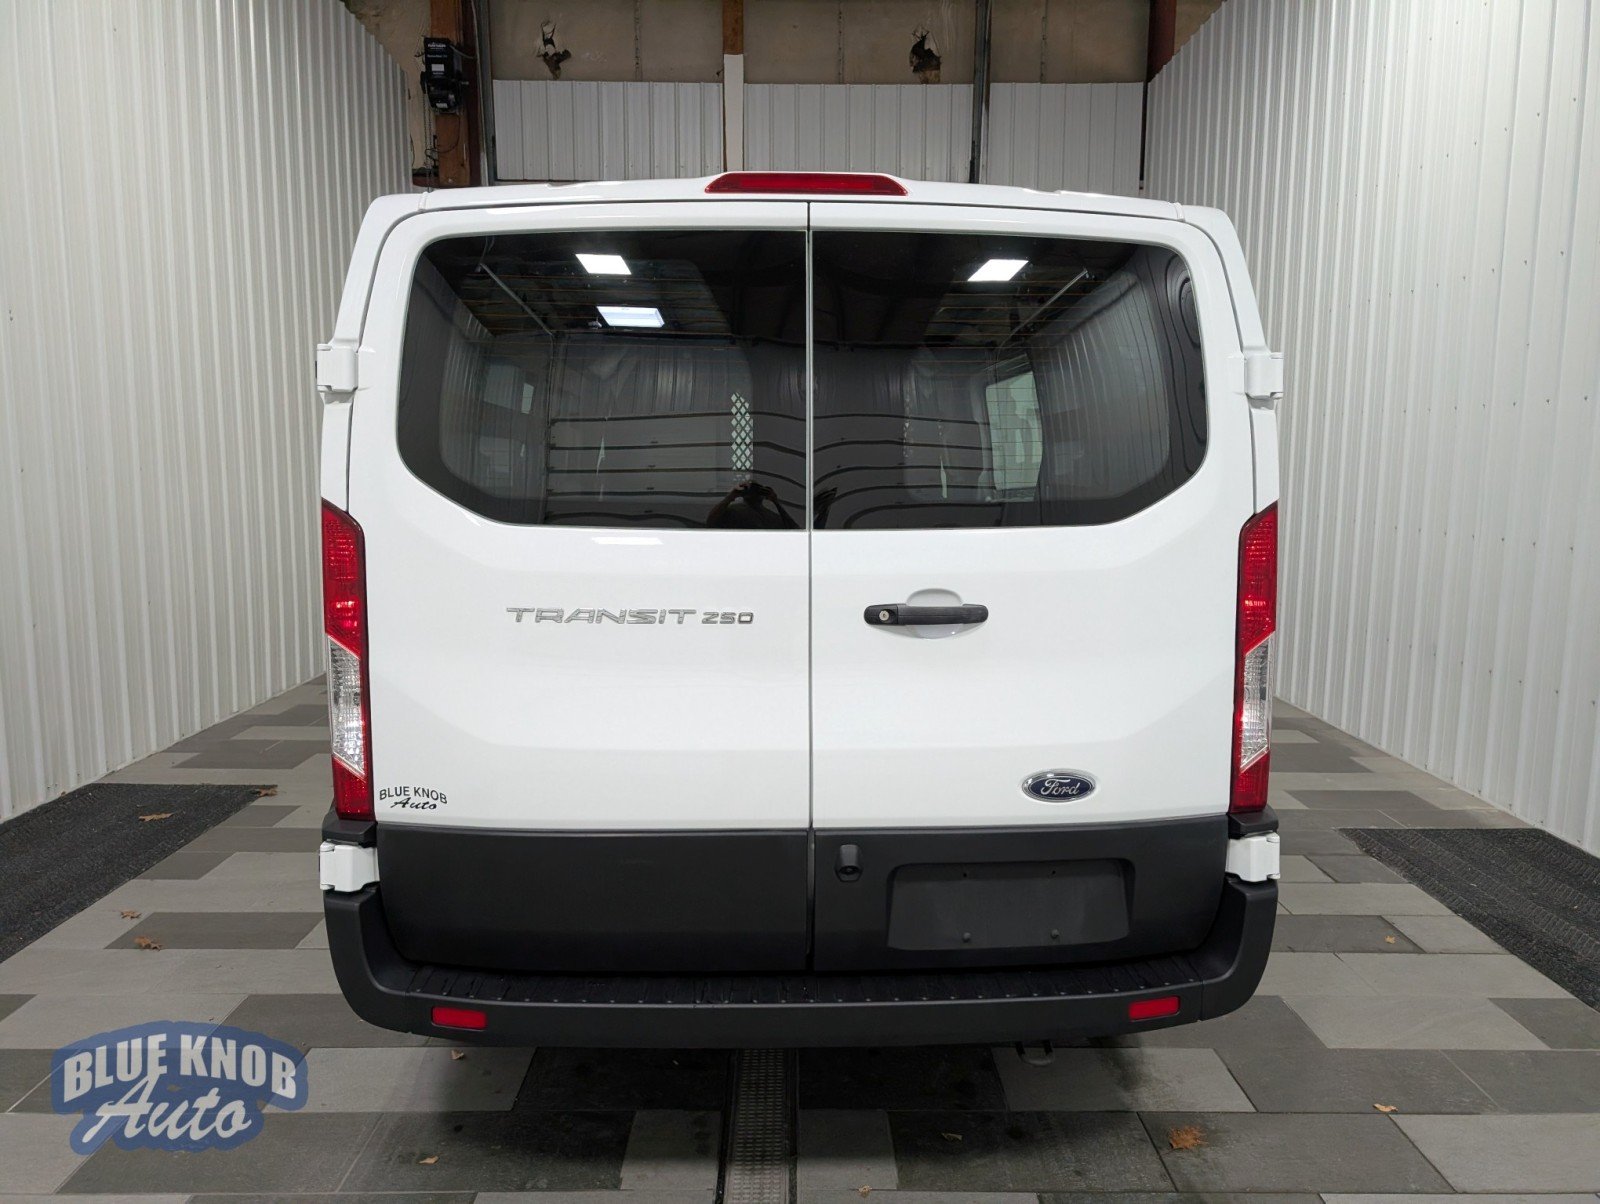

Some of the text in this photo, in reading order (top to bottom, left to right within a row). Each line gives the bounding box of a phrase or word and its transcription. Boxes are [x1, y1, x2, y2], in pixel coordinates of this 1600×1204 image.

[506, 607, 754, 624] TRANSIT 250
[379, 786, 448, 804] BLUE KNOB
[1040, 778, 1081, 795] Ford
[390, 797, 437, 810] Auto
